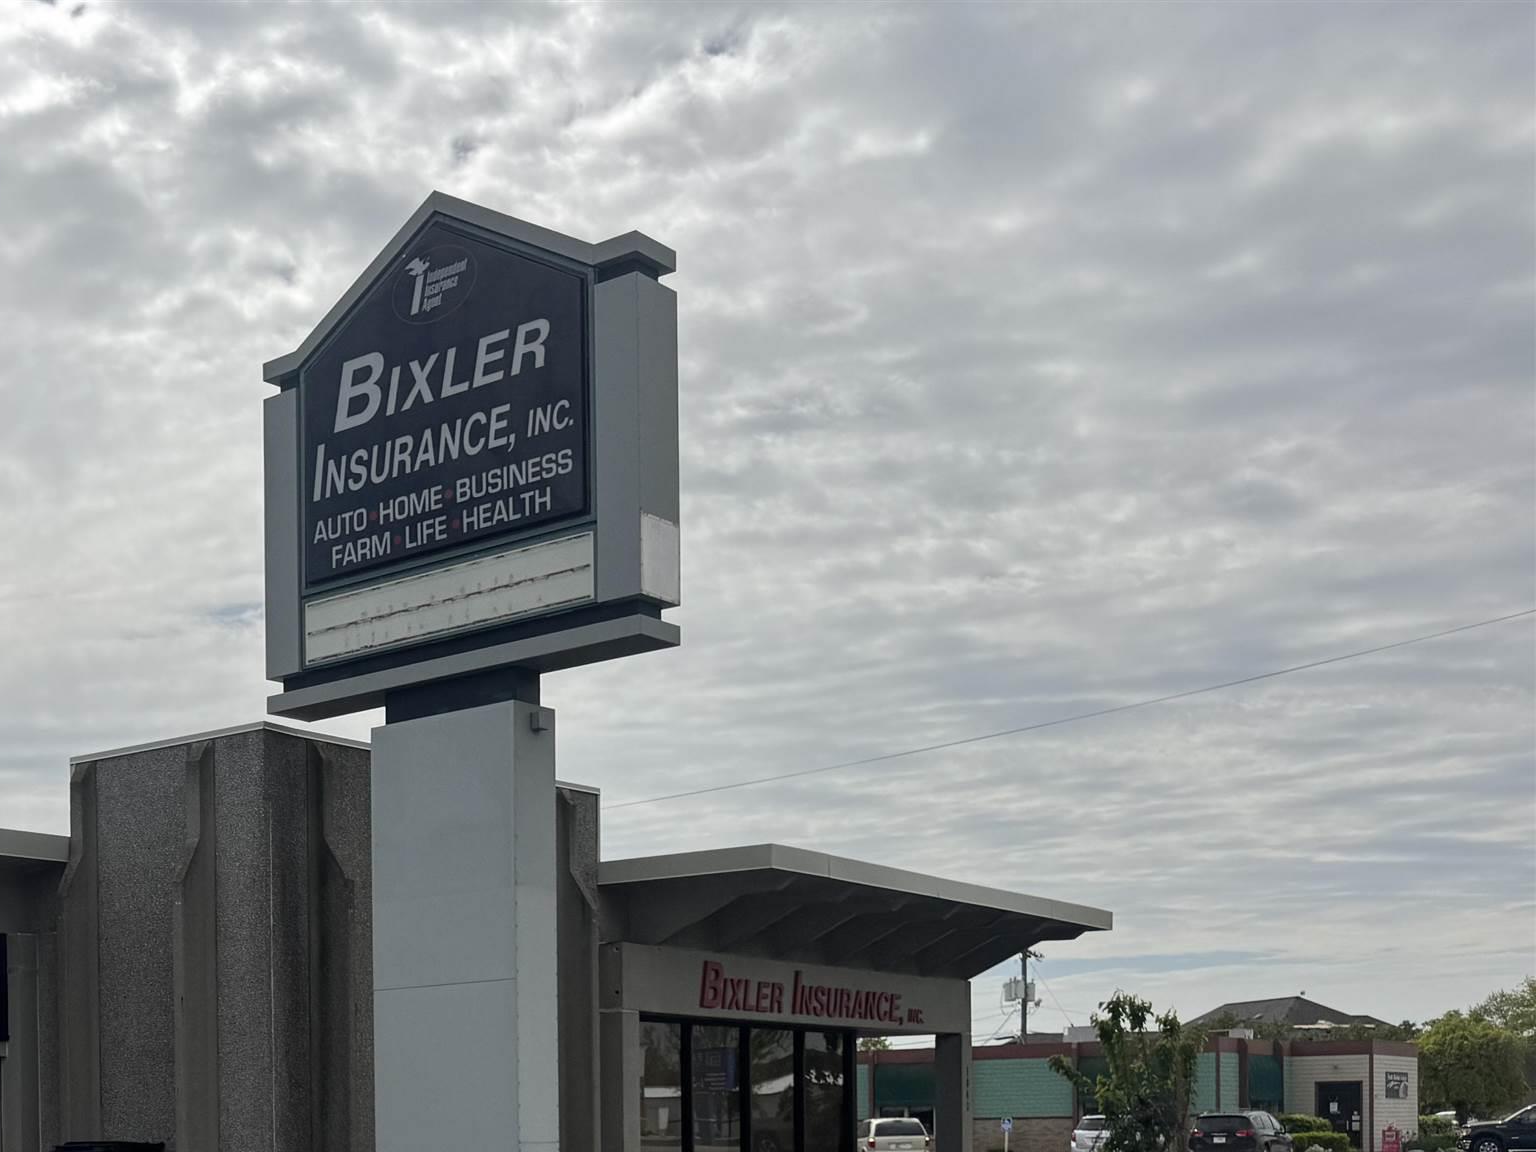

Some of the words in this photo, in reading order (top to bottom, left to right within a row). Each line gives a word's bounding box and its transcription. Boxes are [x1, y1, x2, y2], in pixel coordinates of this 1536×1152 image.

[333, 318, 551, 433] BIXLER
[312, 403, 516, 502] INSURANCE,
[527, 399, 574, 438] INC.
[313, 508, 368, 544] AUTO
[378, 486, 443, 524] HOME
[455, 449, 573, 503] BUSINESS
[332, 532, 391, 569] FARM
[405, 516, 447, 550] LIFE
[462, 487, 552, 533] HEALTH
[699, 959, 785, 1014] BIXLER
[791, 970, 904, 1025] INSURANCE,
